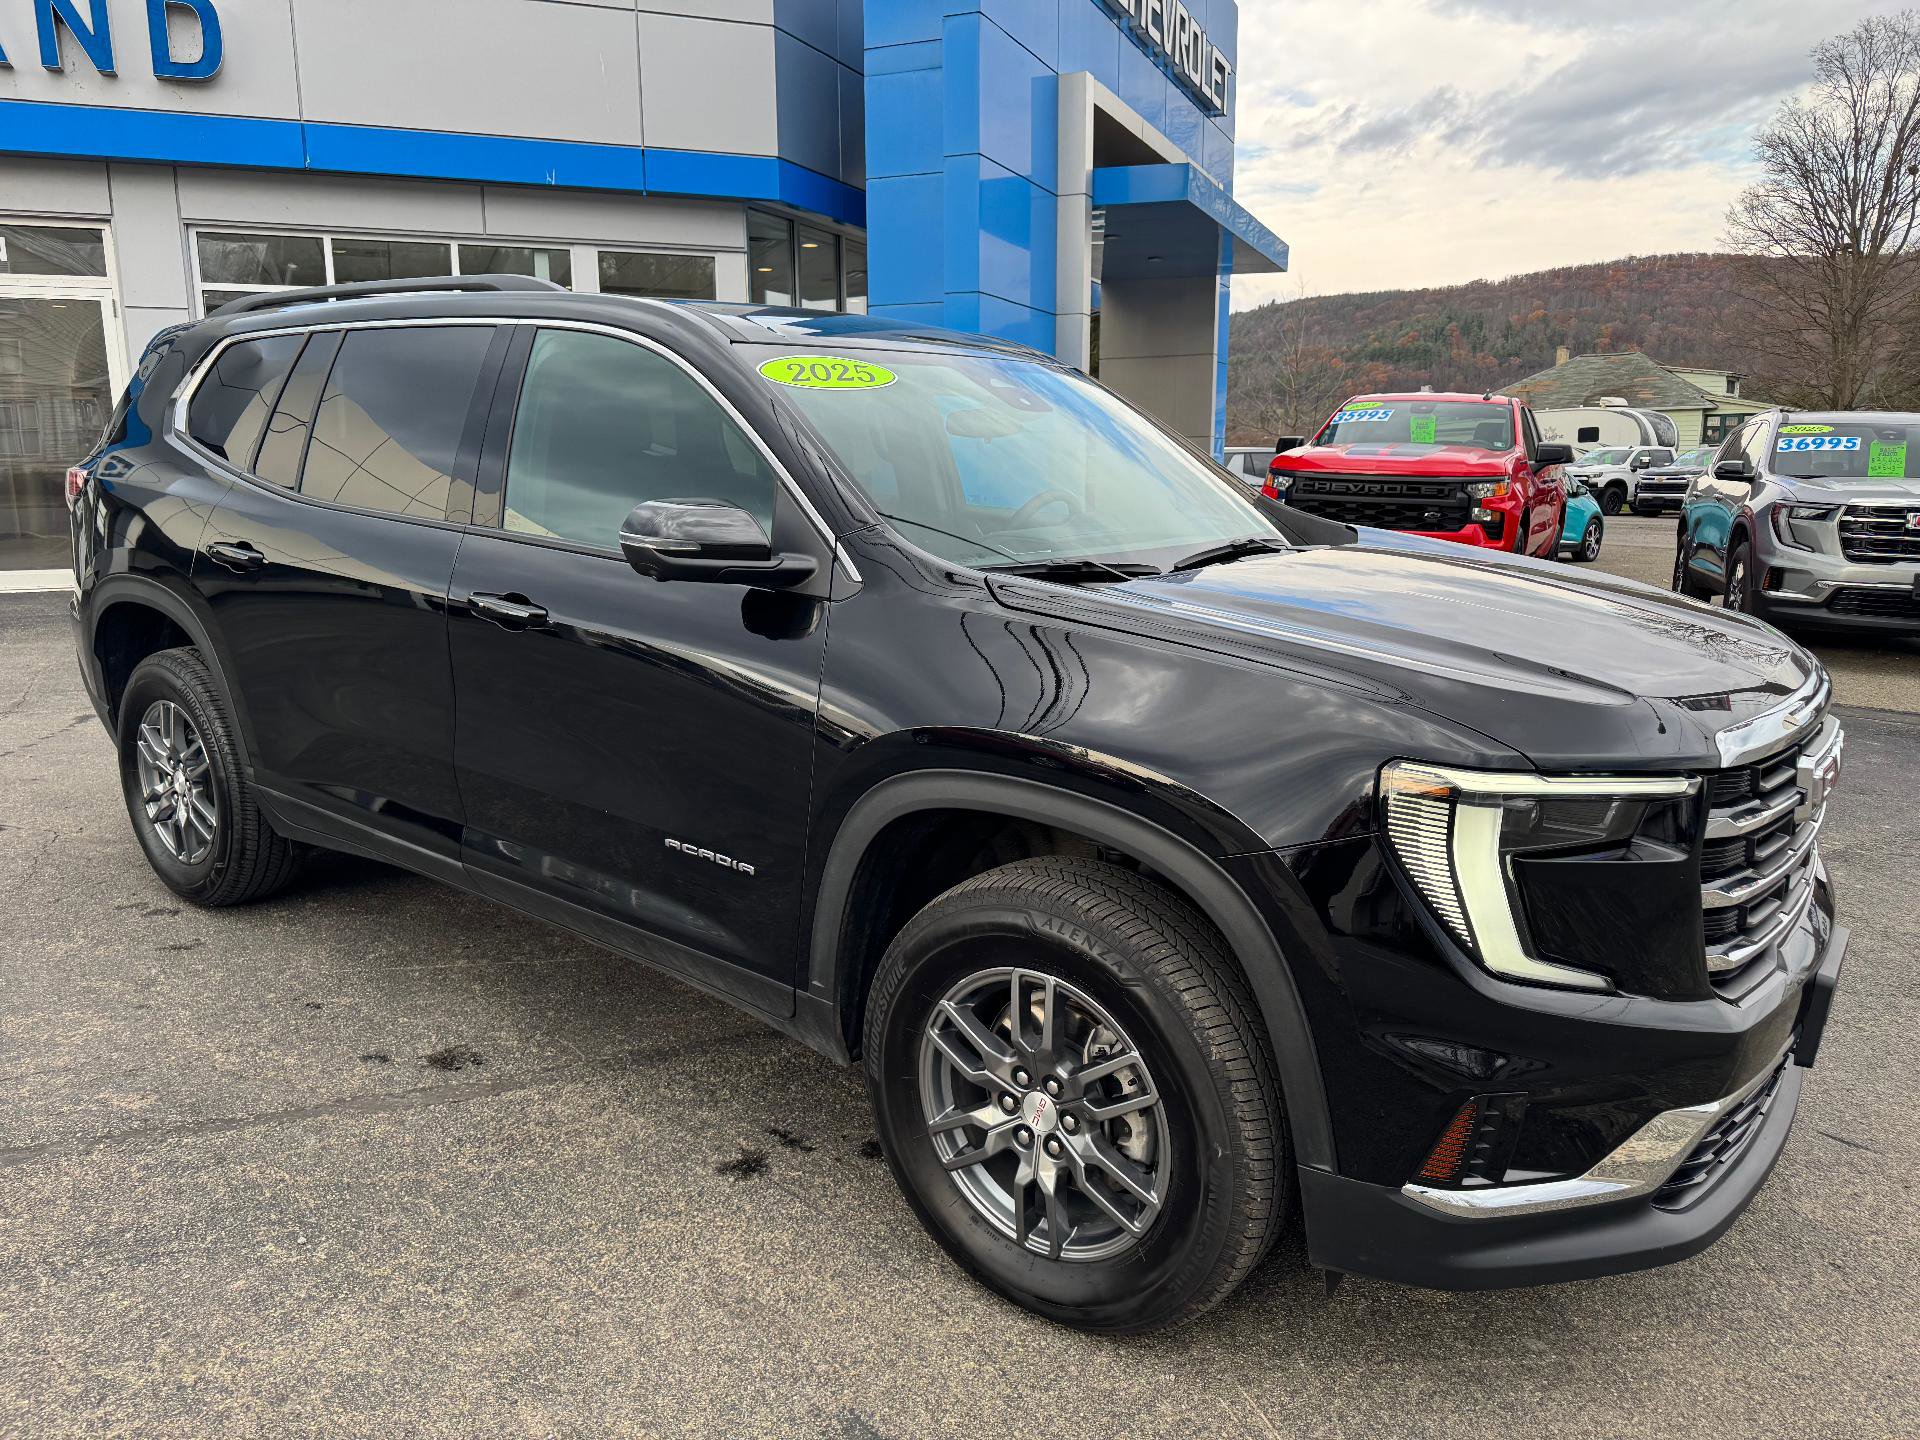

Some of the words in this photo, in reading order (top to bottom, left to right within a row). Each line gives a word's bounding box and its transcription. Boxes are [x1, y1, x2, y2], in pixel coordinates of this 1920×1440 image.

[0, 0, 224, 81] ND
[786, 363, 876, 383] 2025
[1333, 410, 1393, 423] 35995
[1778, 437, 1858, 451] 36995
[1300, 480, 1456, 497] CHEVROLET
[664, 838, 755, 876] ACADIA
[1041, 918, 1125, 974] ALENZA
[1031, 1097, 1047, 1127] GMC
